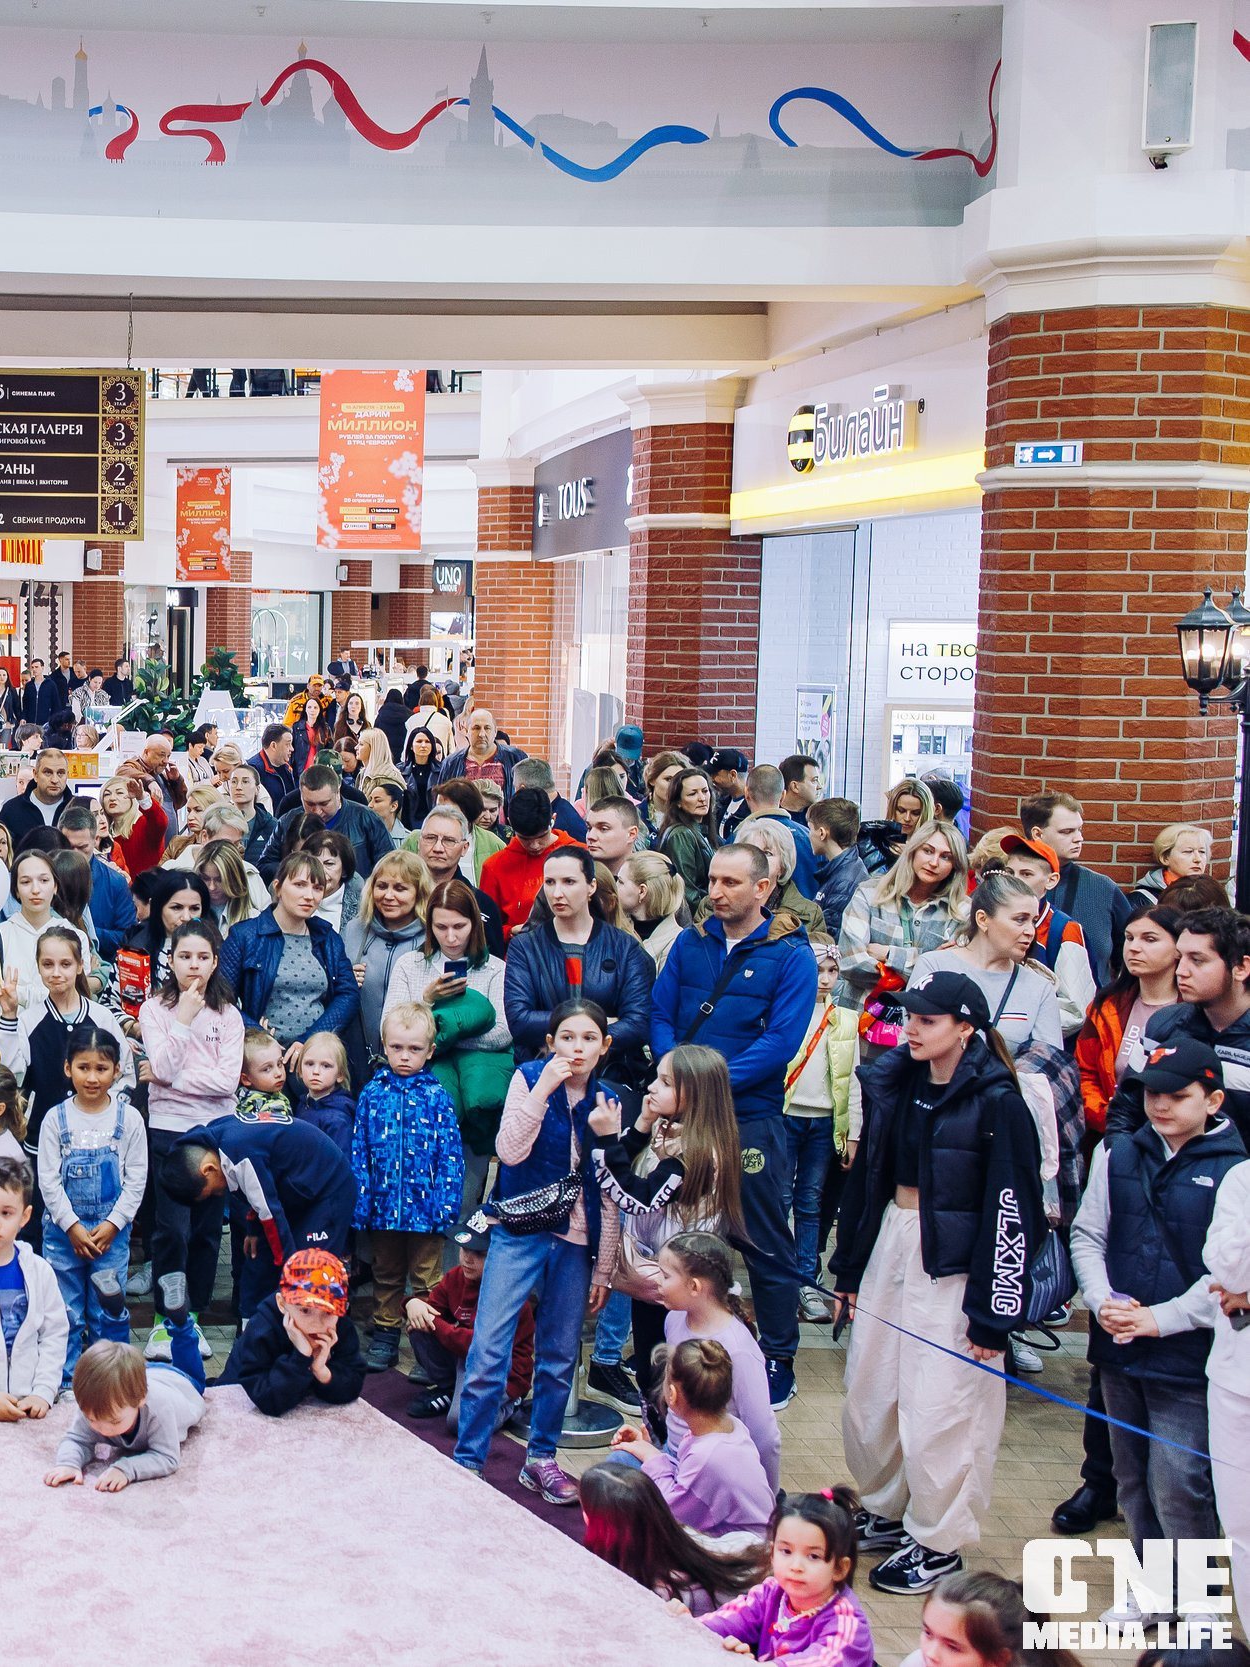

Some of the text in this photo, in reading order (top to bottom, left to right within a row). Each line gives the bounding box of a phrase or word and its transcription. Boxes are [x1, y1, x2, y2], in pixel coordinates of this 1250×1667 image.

[115, 383, 126, 401] 3
[31, 423, 83, 435] ГАЛЕРЕЯ
[114, 423, 126, 441] 3
[328, 420, 417, 431] МИЛЛИОН
[114, 462, 126, 481] 2
[558, 477, 587, 520] TOUS
[114, 502, 124, 521] 1
[45, 517, 86, 525] ПРОДУКТЫ
[436, 566, 461, 584] UNQ
[902, 643, 928, 656] на
[900, 666, 974, 686] сторо
[306, 1231, 328, 1241] FILA
[991, 1188, 1025, 1316] JLXMG
